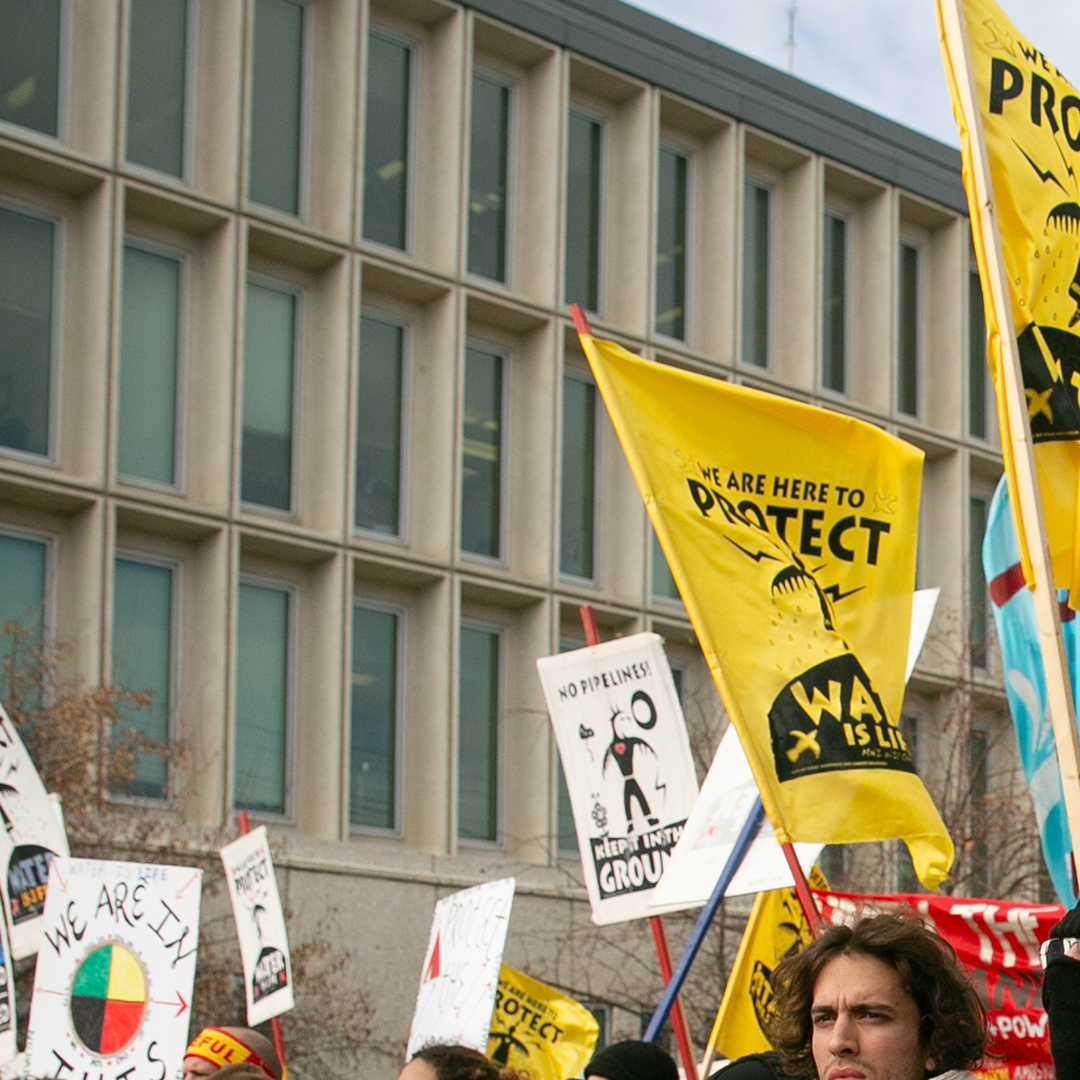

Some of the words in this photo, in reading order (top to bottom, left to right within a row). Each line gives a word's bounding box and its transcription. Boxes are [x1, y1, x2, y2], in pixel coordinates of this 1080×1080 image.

[697, 462, 722, 487] WE
[726, 471, 767, 495] ARE
[772, 476, 829, 503] HERE
[835, 486, 865, 508] TO
[686, 478, 891, 568] PROTECT
[558, 682, 577, 702] NO
[580, 661, 652, 695] PIPELINES!
[843, 722, 871, 746] IS
[594, 836, 629, 860] KEEP
[642, 831, 662, 849] IN
[663, 825, 686, 845] TH
[600, 848, 672, 893] GROU
[44, 901, 87, 957] WE
[95, 881, 146, 928] ARE
[147, 900, 198, 969] IN
[496, 990, 563, 1043] ROTECT
[996, 1012, 1049, 1040] POW
